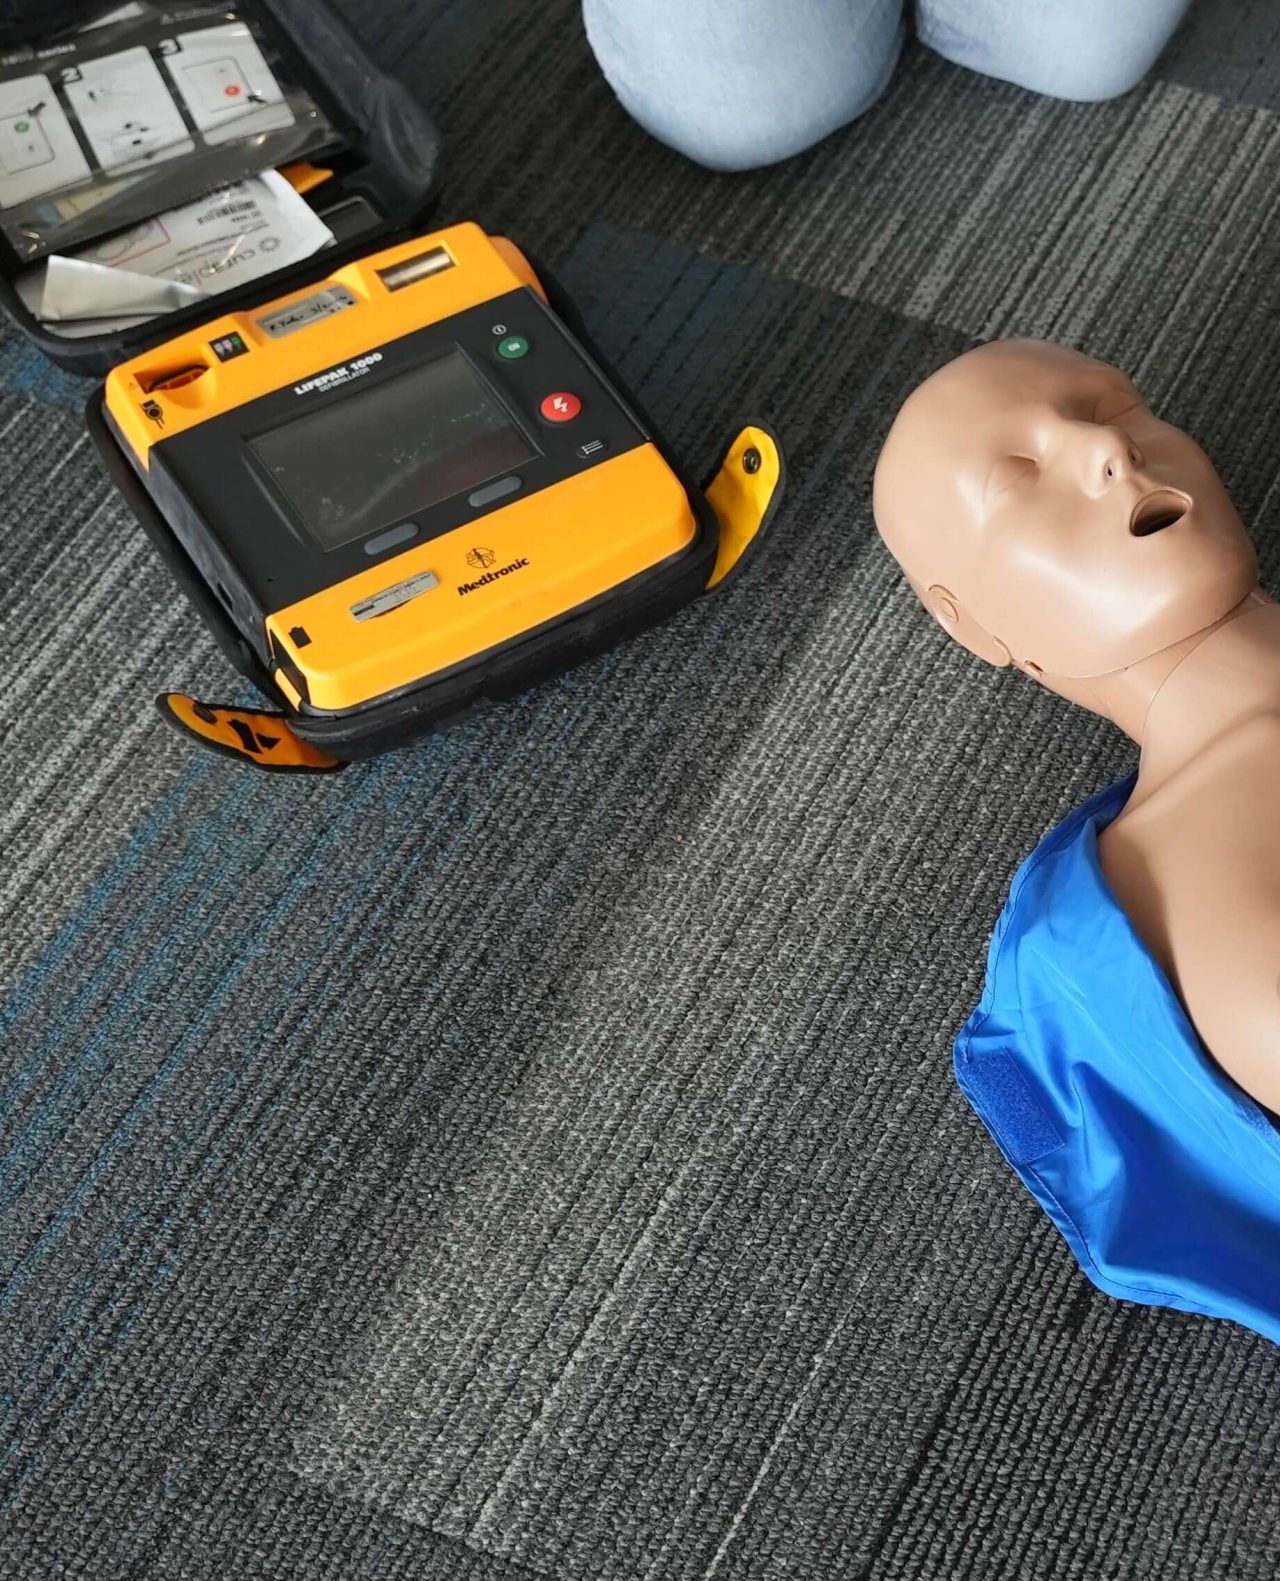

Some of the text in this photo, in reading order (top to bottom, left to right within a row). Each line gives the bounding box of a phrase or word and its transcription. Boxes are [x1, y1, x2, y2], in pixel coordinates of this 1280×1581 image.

[158, 39, 178, 55] 3
[61, 67, 79, 82] 2
[294, 352, 383, 395] LIFEPAK 1000
[319, 366, 371, 392] DEFIBRILLATOR
[457, 557, 530, 596] Medtronic
